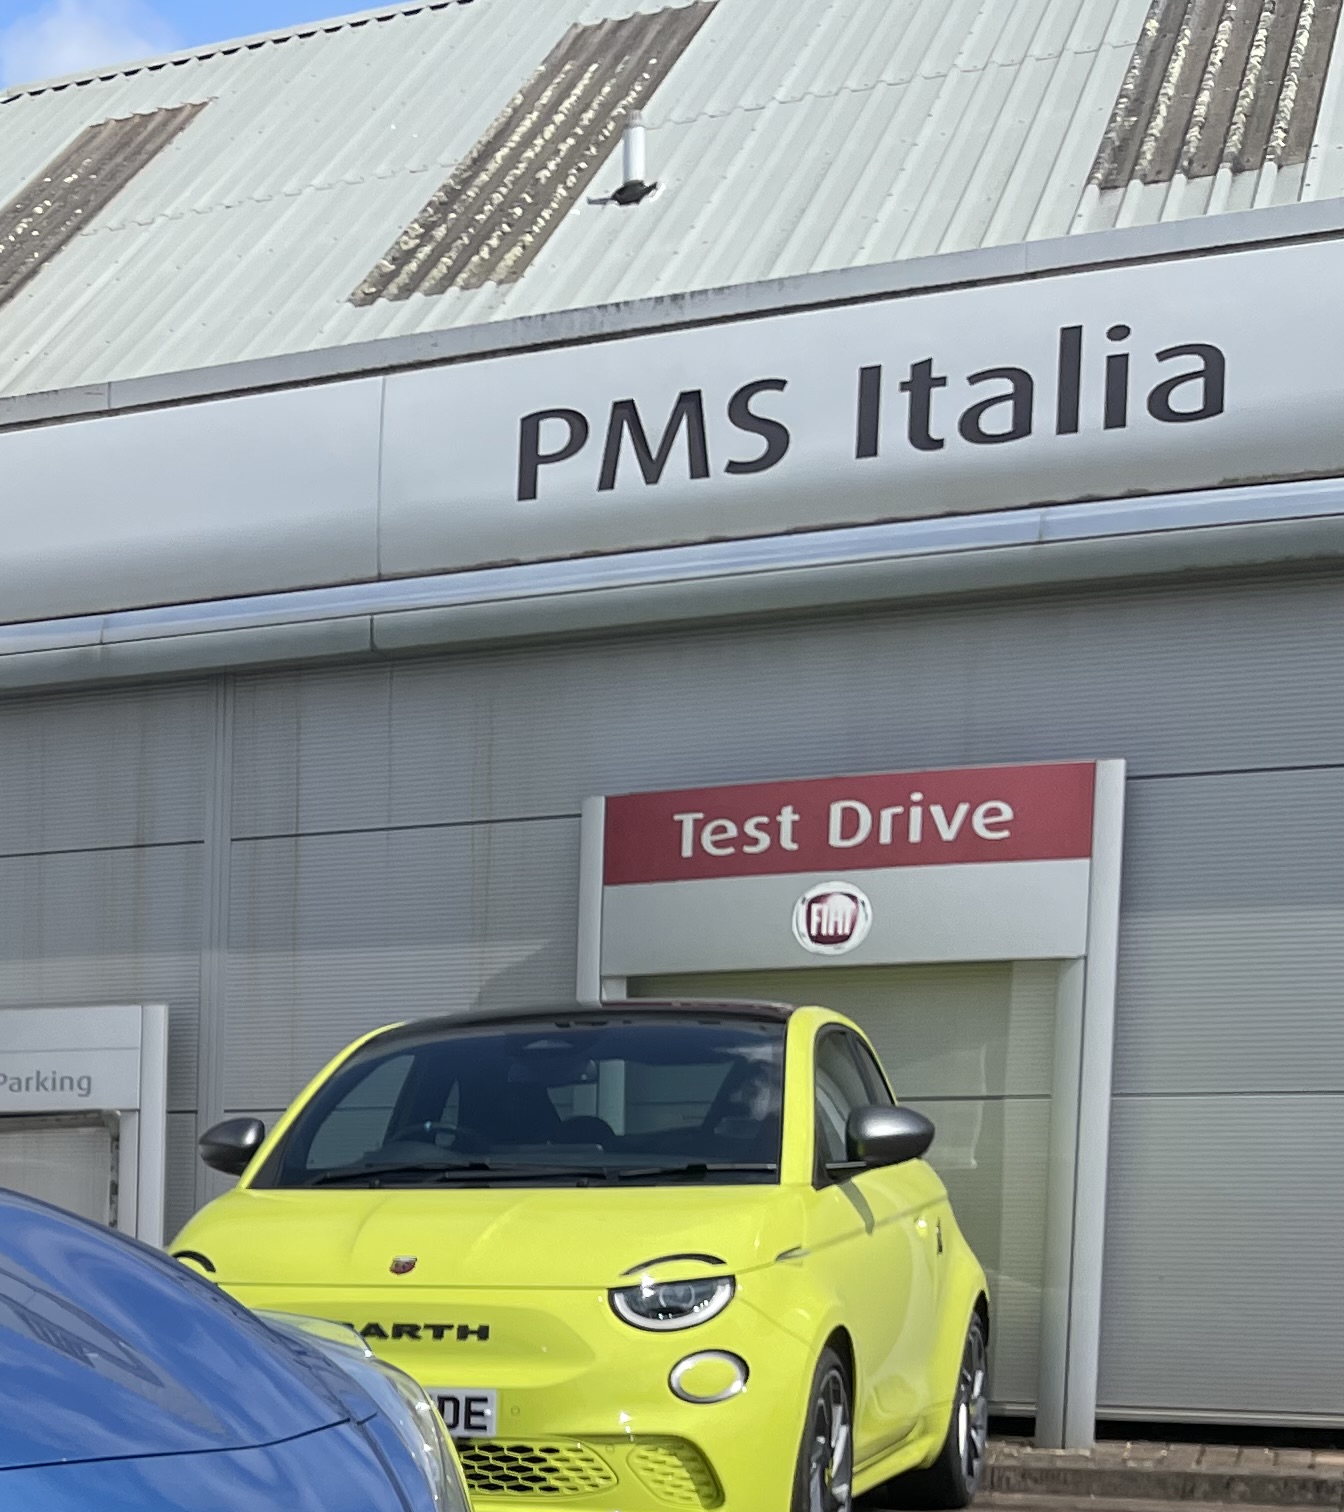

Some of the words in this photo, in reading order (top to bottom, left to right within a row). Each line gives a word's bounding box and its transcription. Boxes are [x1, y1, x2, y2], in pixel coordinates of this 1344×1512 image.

[517, 377, 790, 501] PMS
[855, 323, 1227, 460] Italia
[672, 804, 801, 858] Test
[827, 791, 1015, 849] Drive
[810, 899, 856, 937] FIAT
[339, 1322, 490, 1341] ARTH
[433, 1395, 489, 1433] DE
